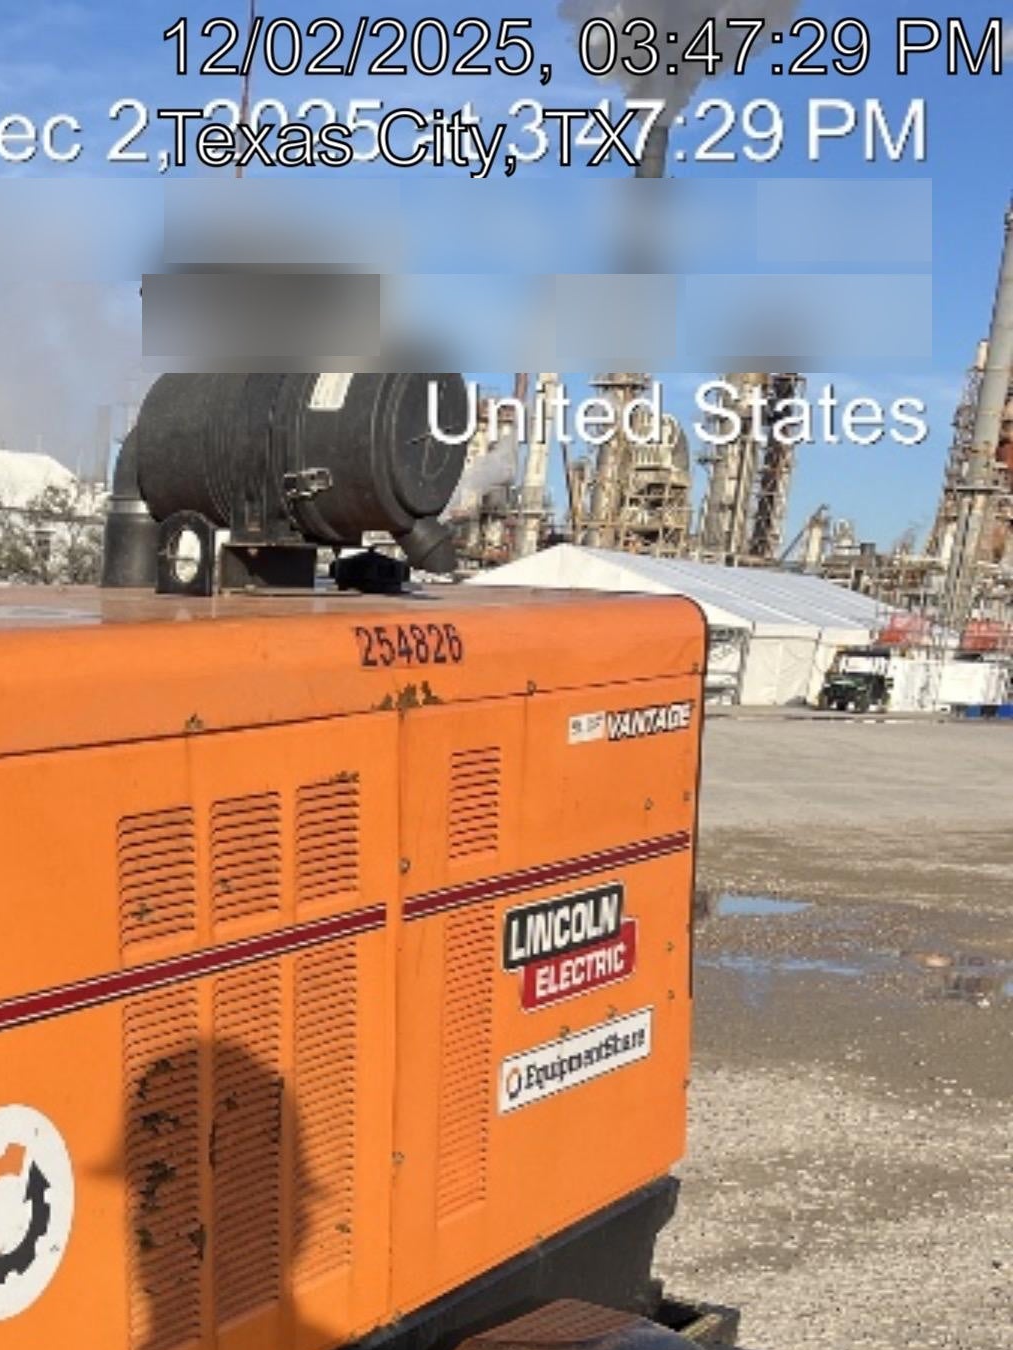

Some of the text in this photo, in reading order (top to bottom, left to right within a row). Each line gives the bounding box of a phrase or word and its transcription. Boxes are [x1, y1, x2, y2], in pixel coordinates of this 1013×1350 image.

[354, 623, 463, 667] 254826
[510, 893, 619, 961] LINCOLN
[535, 942, 626, 999] ELECTRIC
[525, 1028, 646, 1089] EquipmentShare
